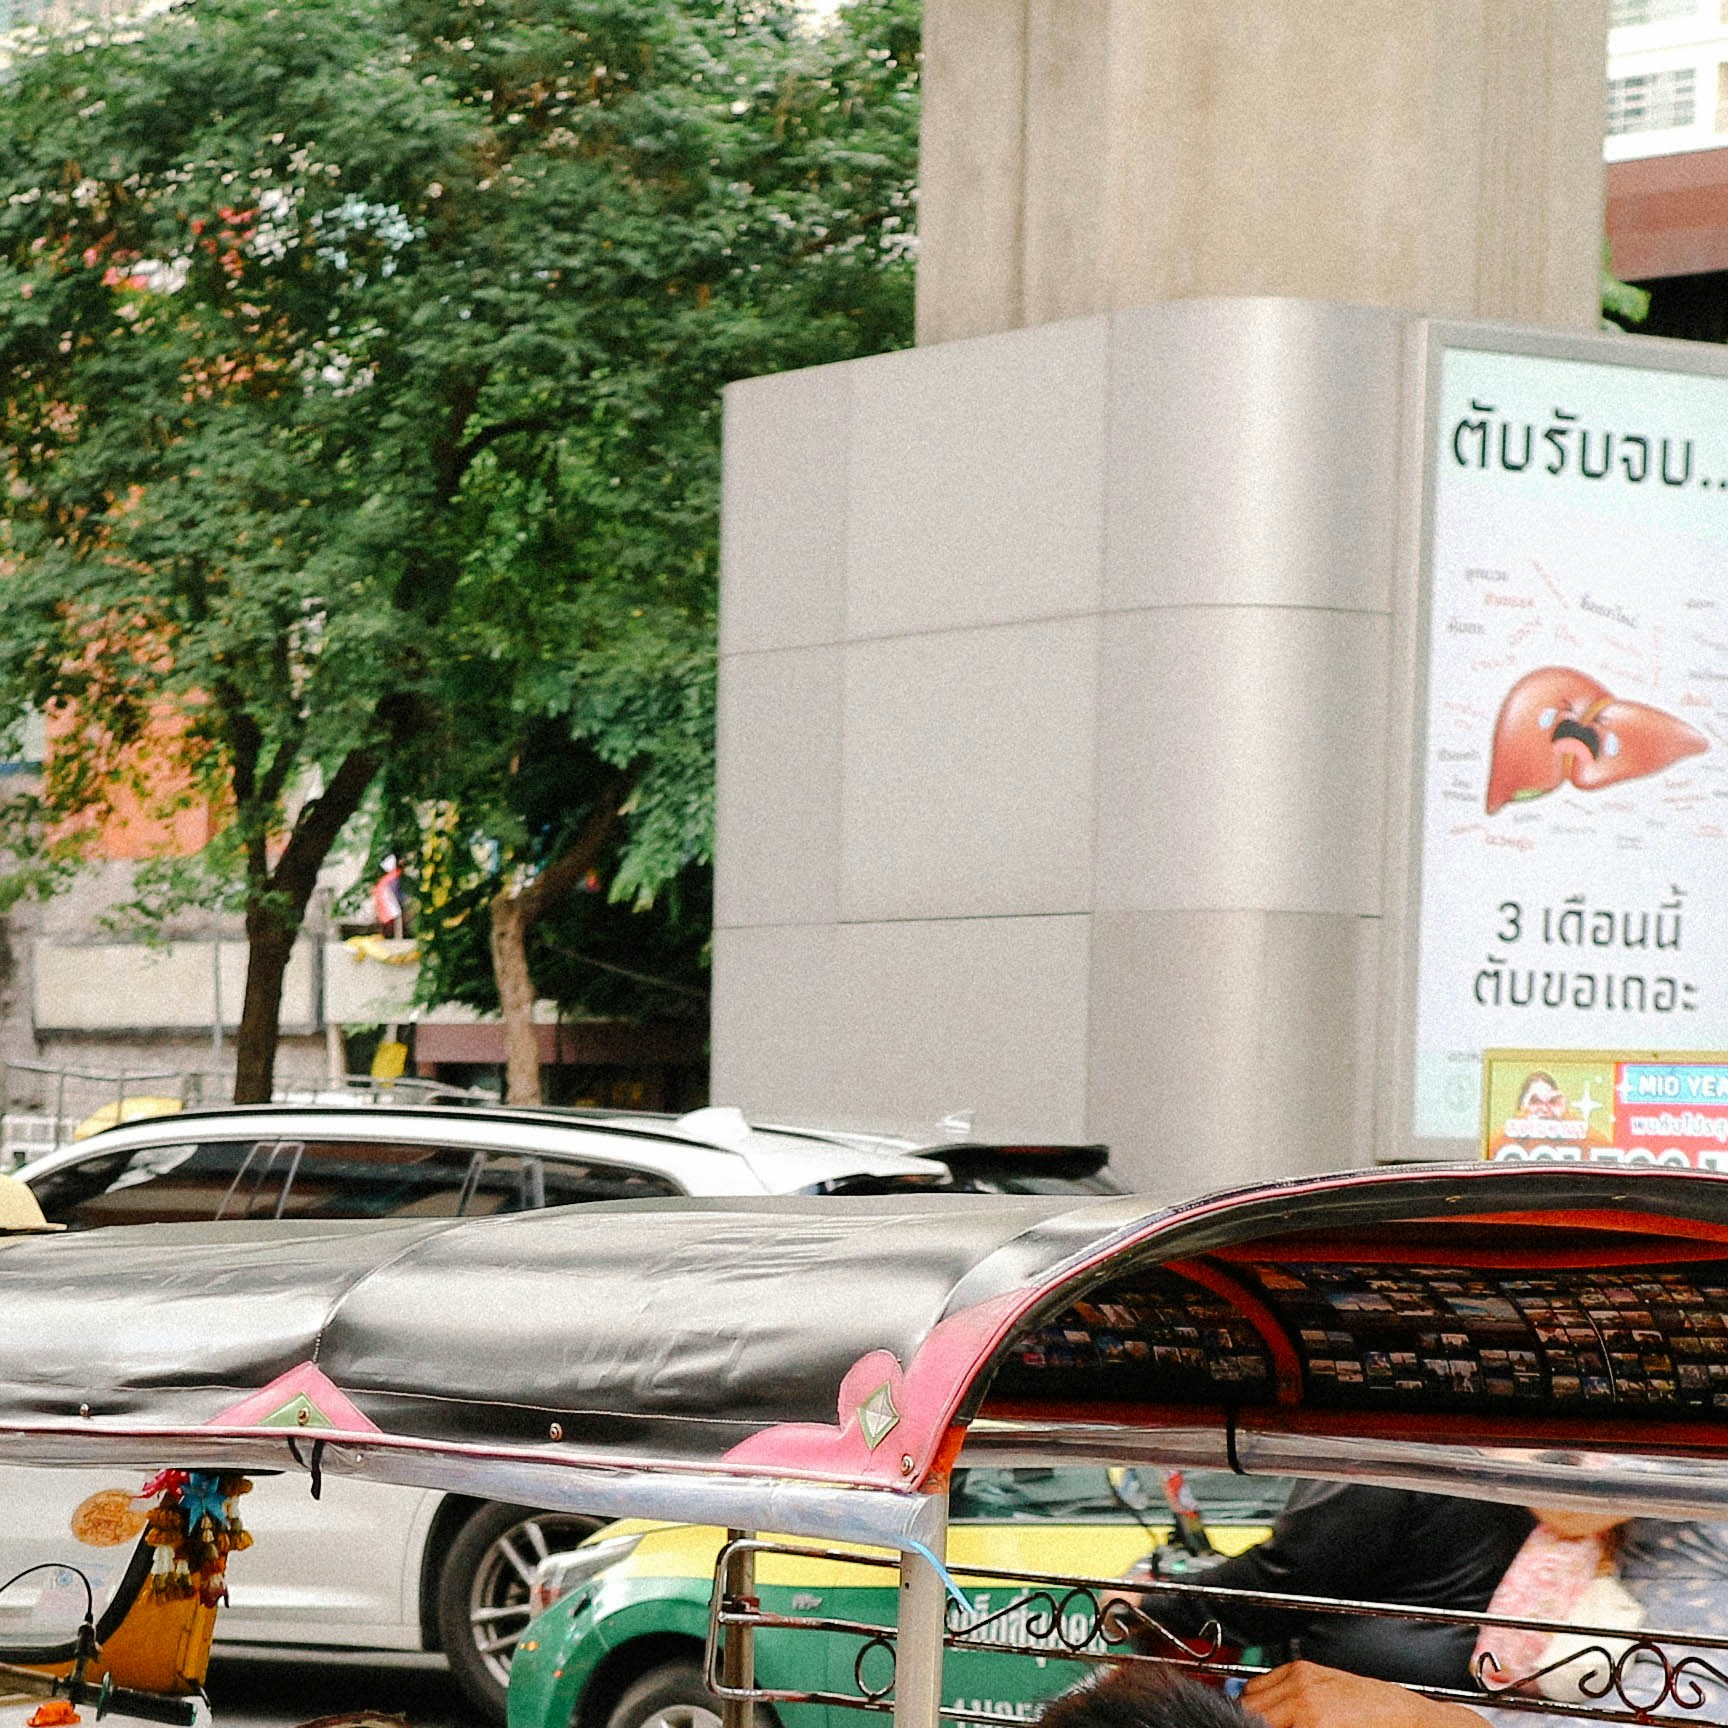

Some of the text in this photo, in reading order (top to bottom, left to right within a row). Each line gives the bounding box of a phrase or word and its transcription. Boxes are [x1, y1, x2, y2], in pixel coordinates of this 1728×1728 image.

[1496, 884, 1688, 951] 3 เดือนนี้
[1474, 956, 1699, 1013] ตับขอเถอะ
